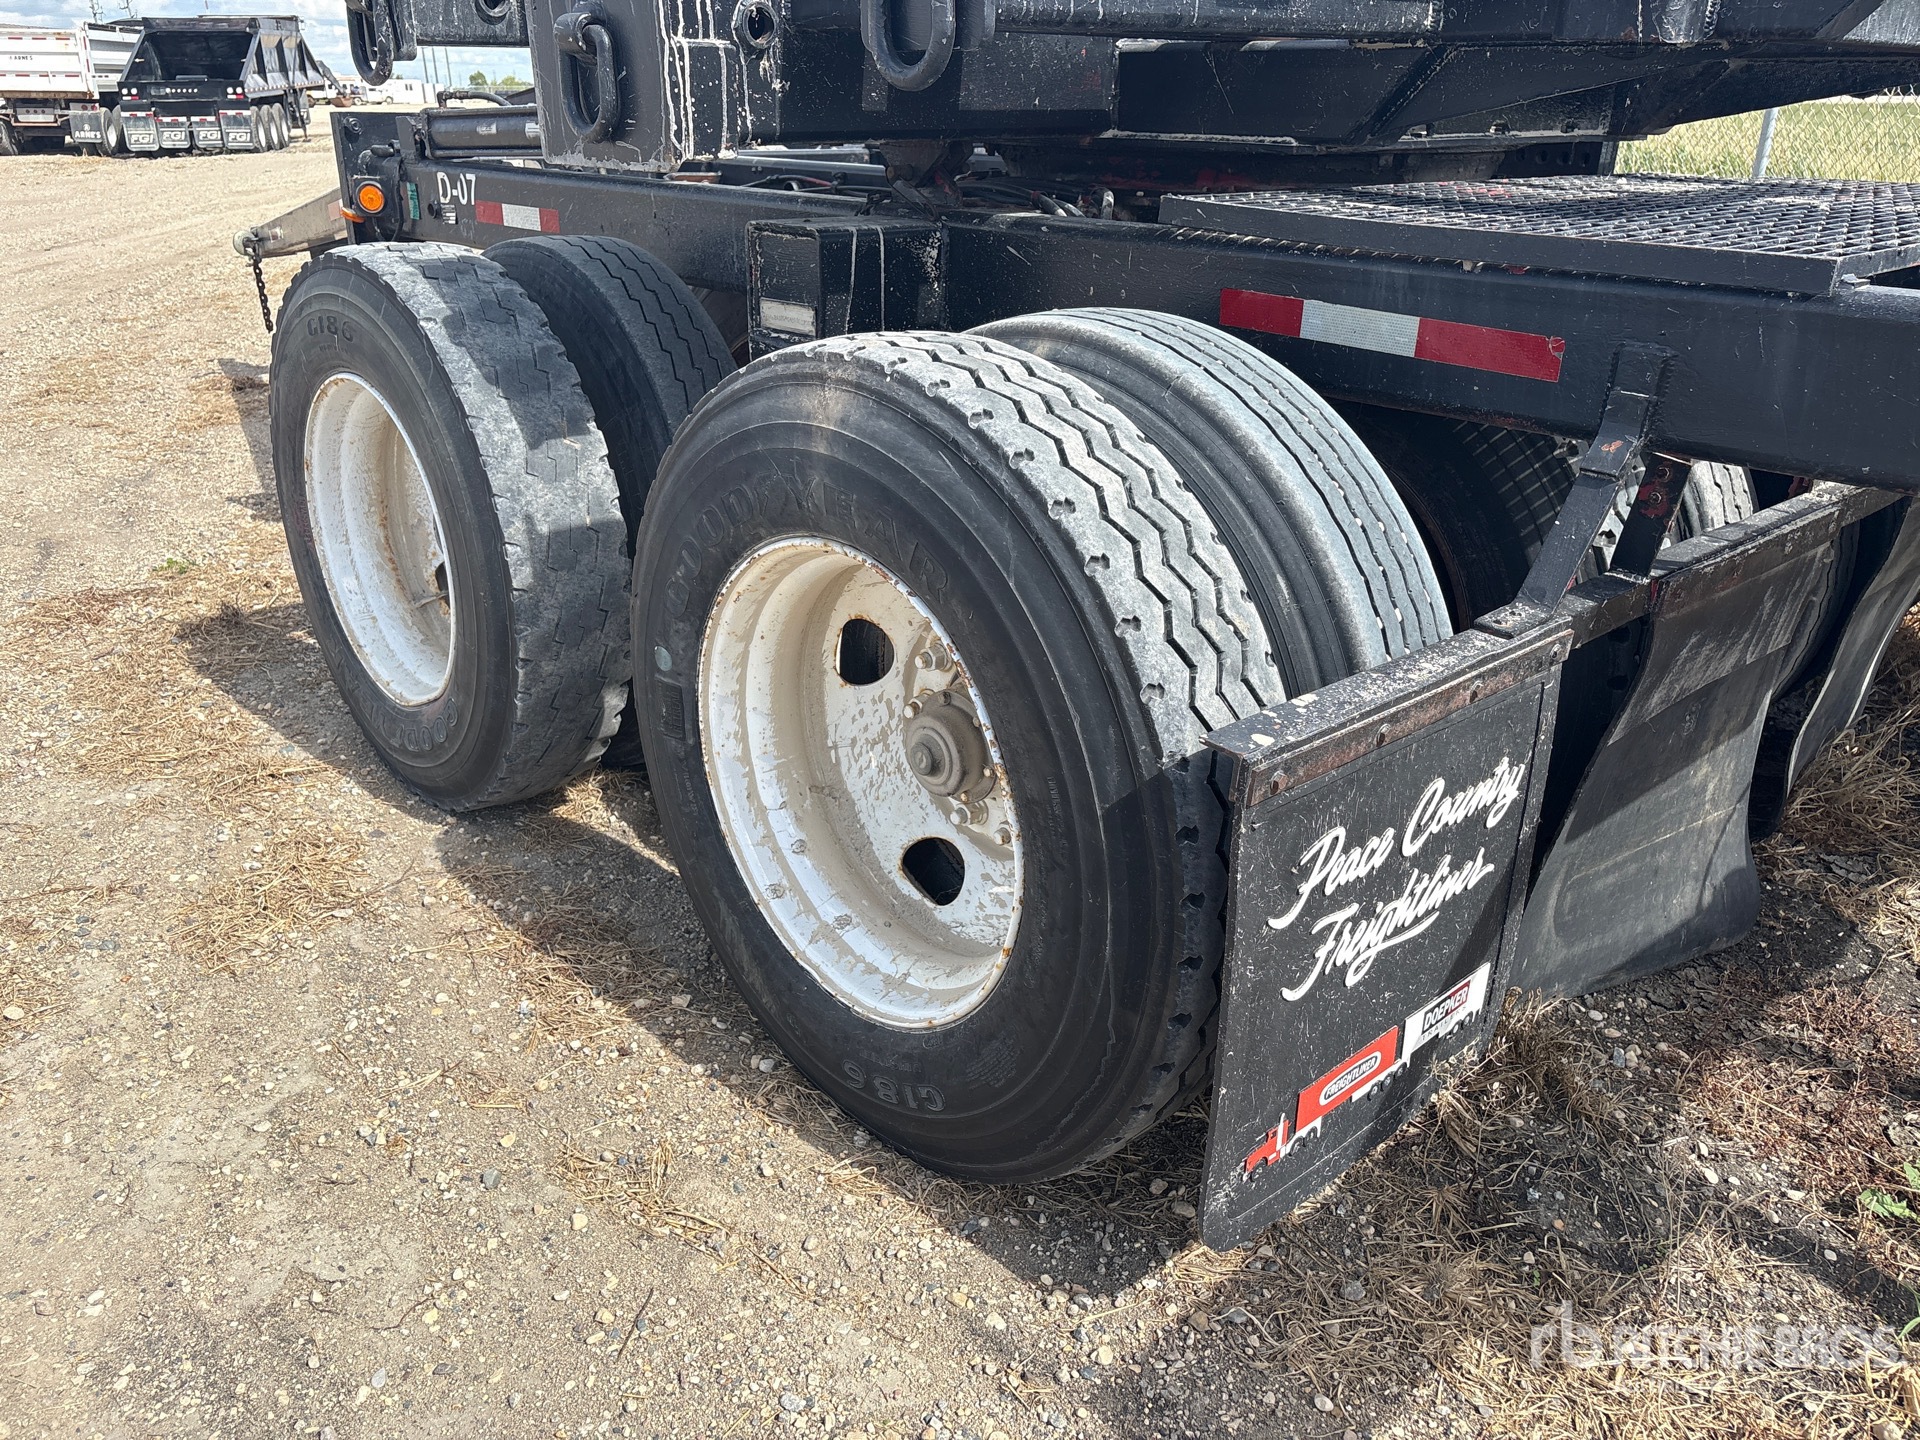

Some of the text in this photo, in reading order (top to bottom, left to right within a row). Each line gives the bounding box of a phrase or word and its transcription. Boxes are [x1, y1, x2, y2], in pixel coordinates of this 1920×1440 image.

[131, 134, 154, 143] FGI
[163, 131, 186, 140] FGI
[199, 130, 220, 140] FGI
[228, 132, 251, 142] FGI
[437, 171, 476, 206] D-07
[1268, 757, 1526, 930] Peace Country
[1281, 847, 1495, 1002] Freightliner
[1423, 986, 1468, 1031] DOEPKER
[842, 1060, 946, 1112] G186
[1325, 1057, 1376, 1099] FREIGHTLINER
